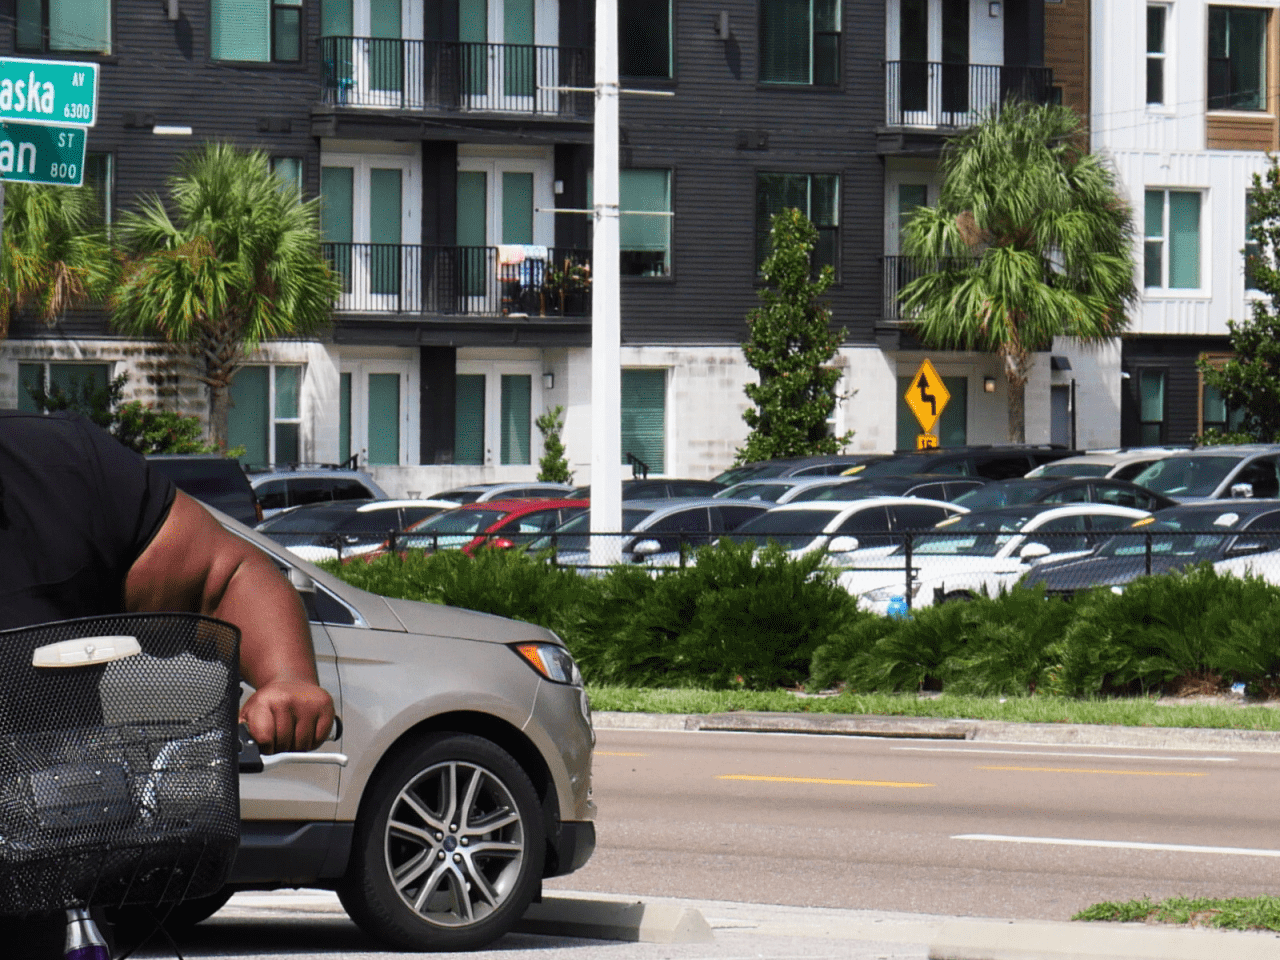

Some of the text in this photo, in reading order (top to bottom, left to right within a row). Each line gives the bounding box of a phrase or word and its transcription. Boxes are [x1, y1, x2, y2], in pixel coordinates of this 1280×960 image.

[72, 72, 85, 87] AV
[63, 103, 90, 119] 6300
[58, 132, 75, 148] ST
[50, 162, 77, 180] 800
